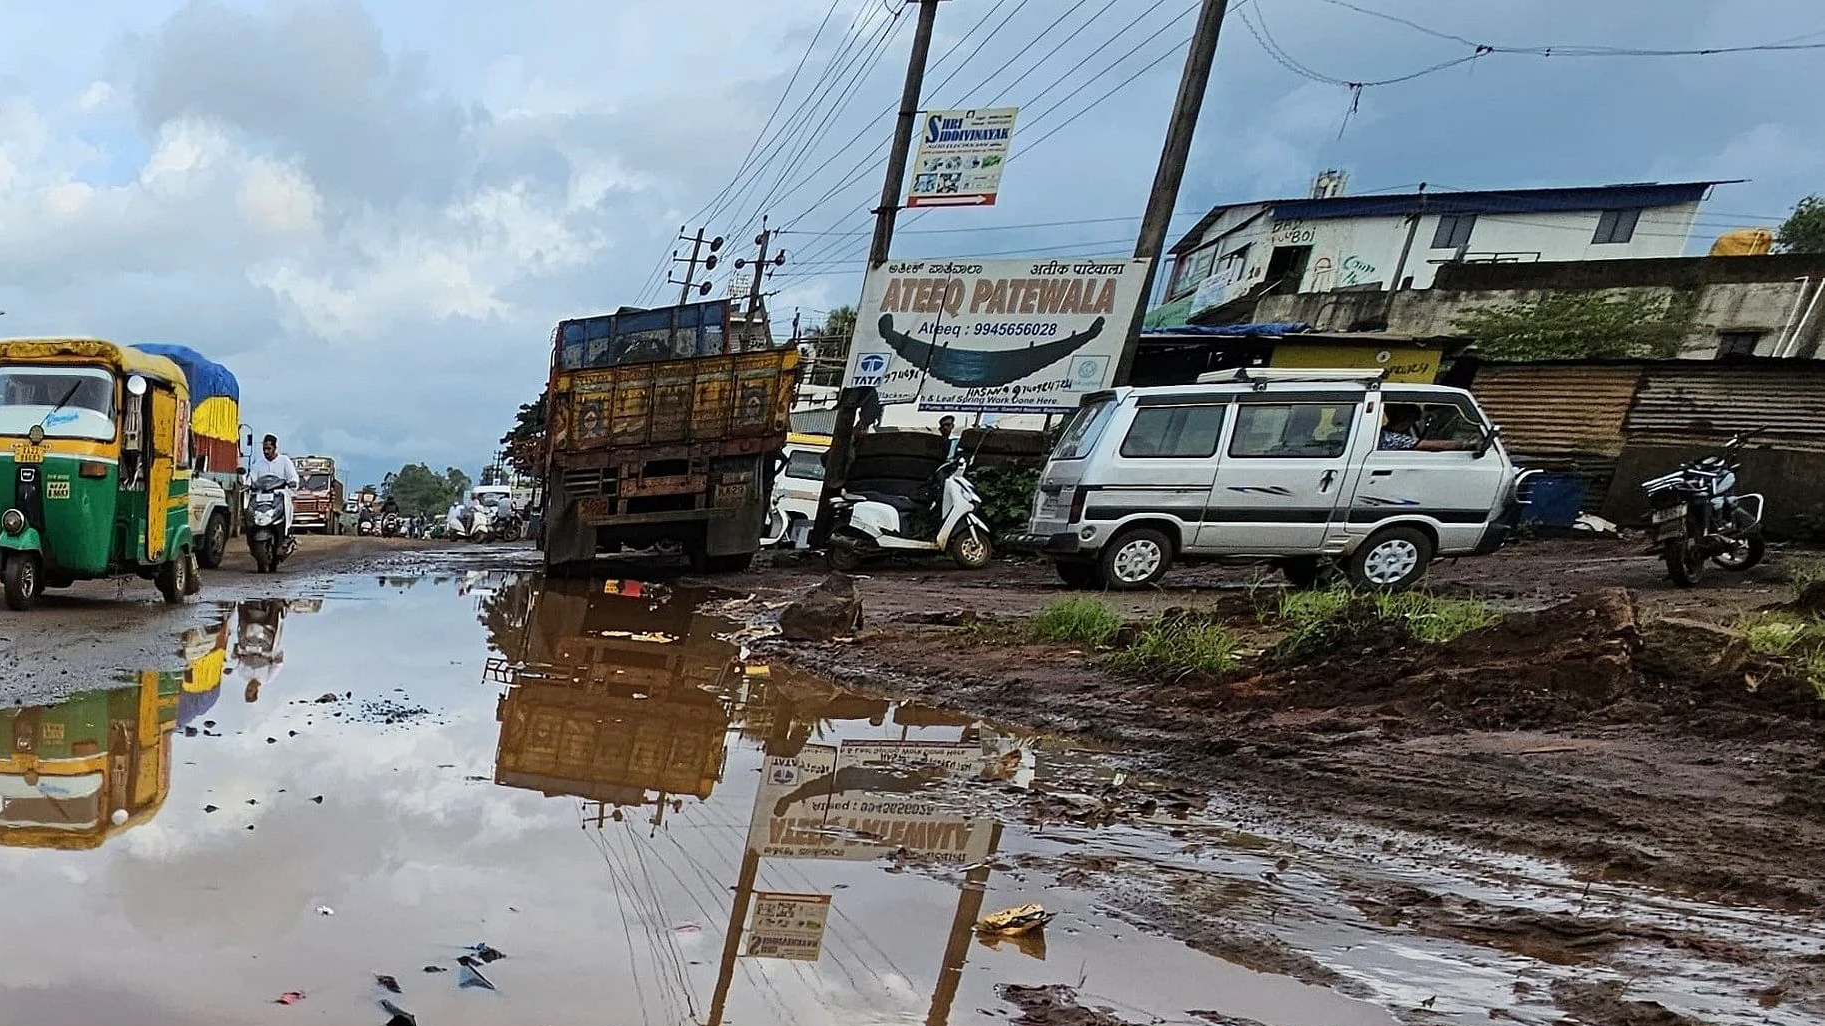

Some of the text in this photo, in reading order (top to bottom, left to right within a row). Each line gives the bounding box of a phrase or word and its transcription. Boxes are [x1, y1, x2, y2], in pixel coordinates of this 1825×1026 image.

[1030, 260, 1125, 275] अतीक पाटेवाला
[879, 278, 1117, 318] ATEEQ PATEWALA
[918, 322, 961, 338] Ateeq
[973, 323, 1057, 336] 9945656028
[853, 376, 881, 385] TATA
